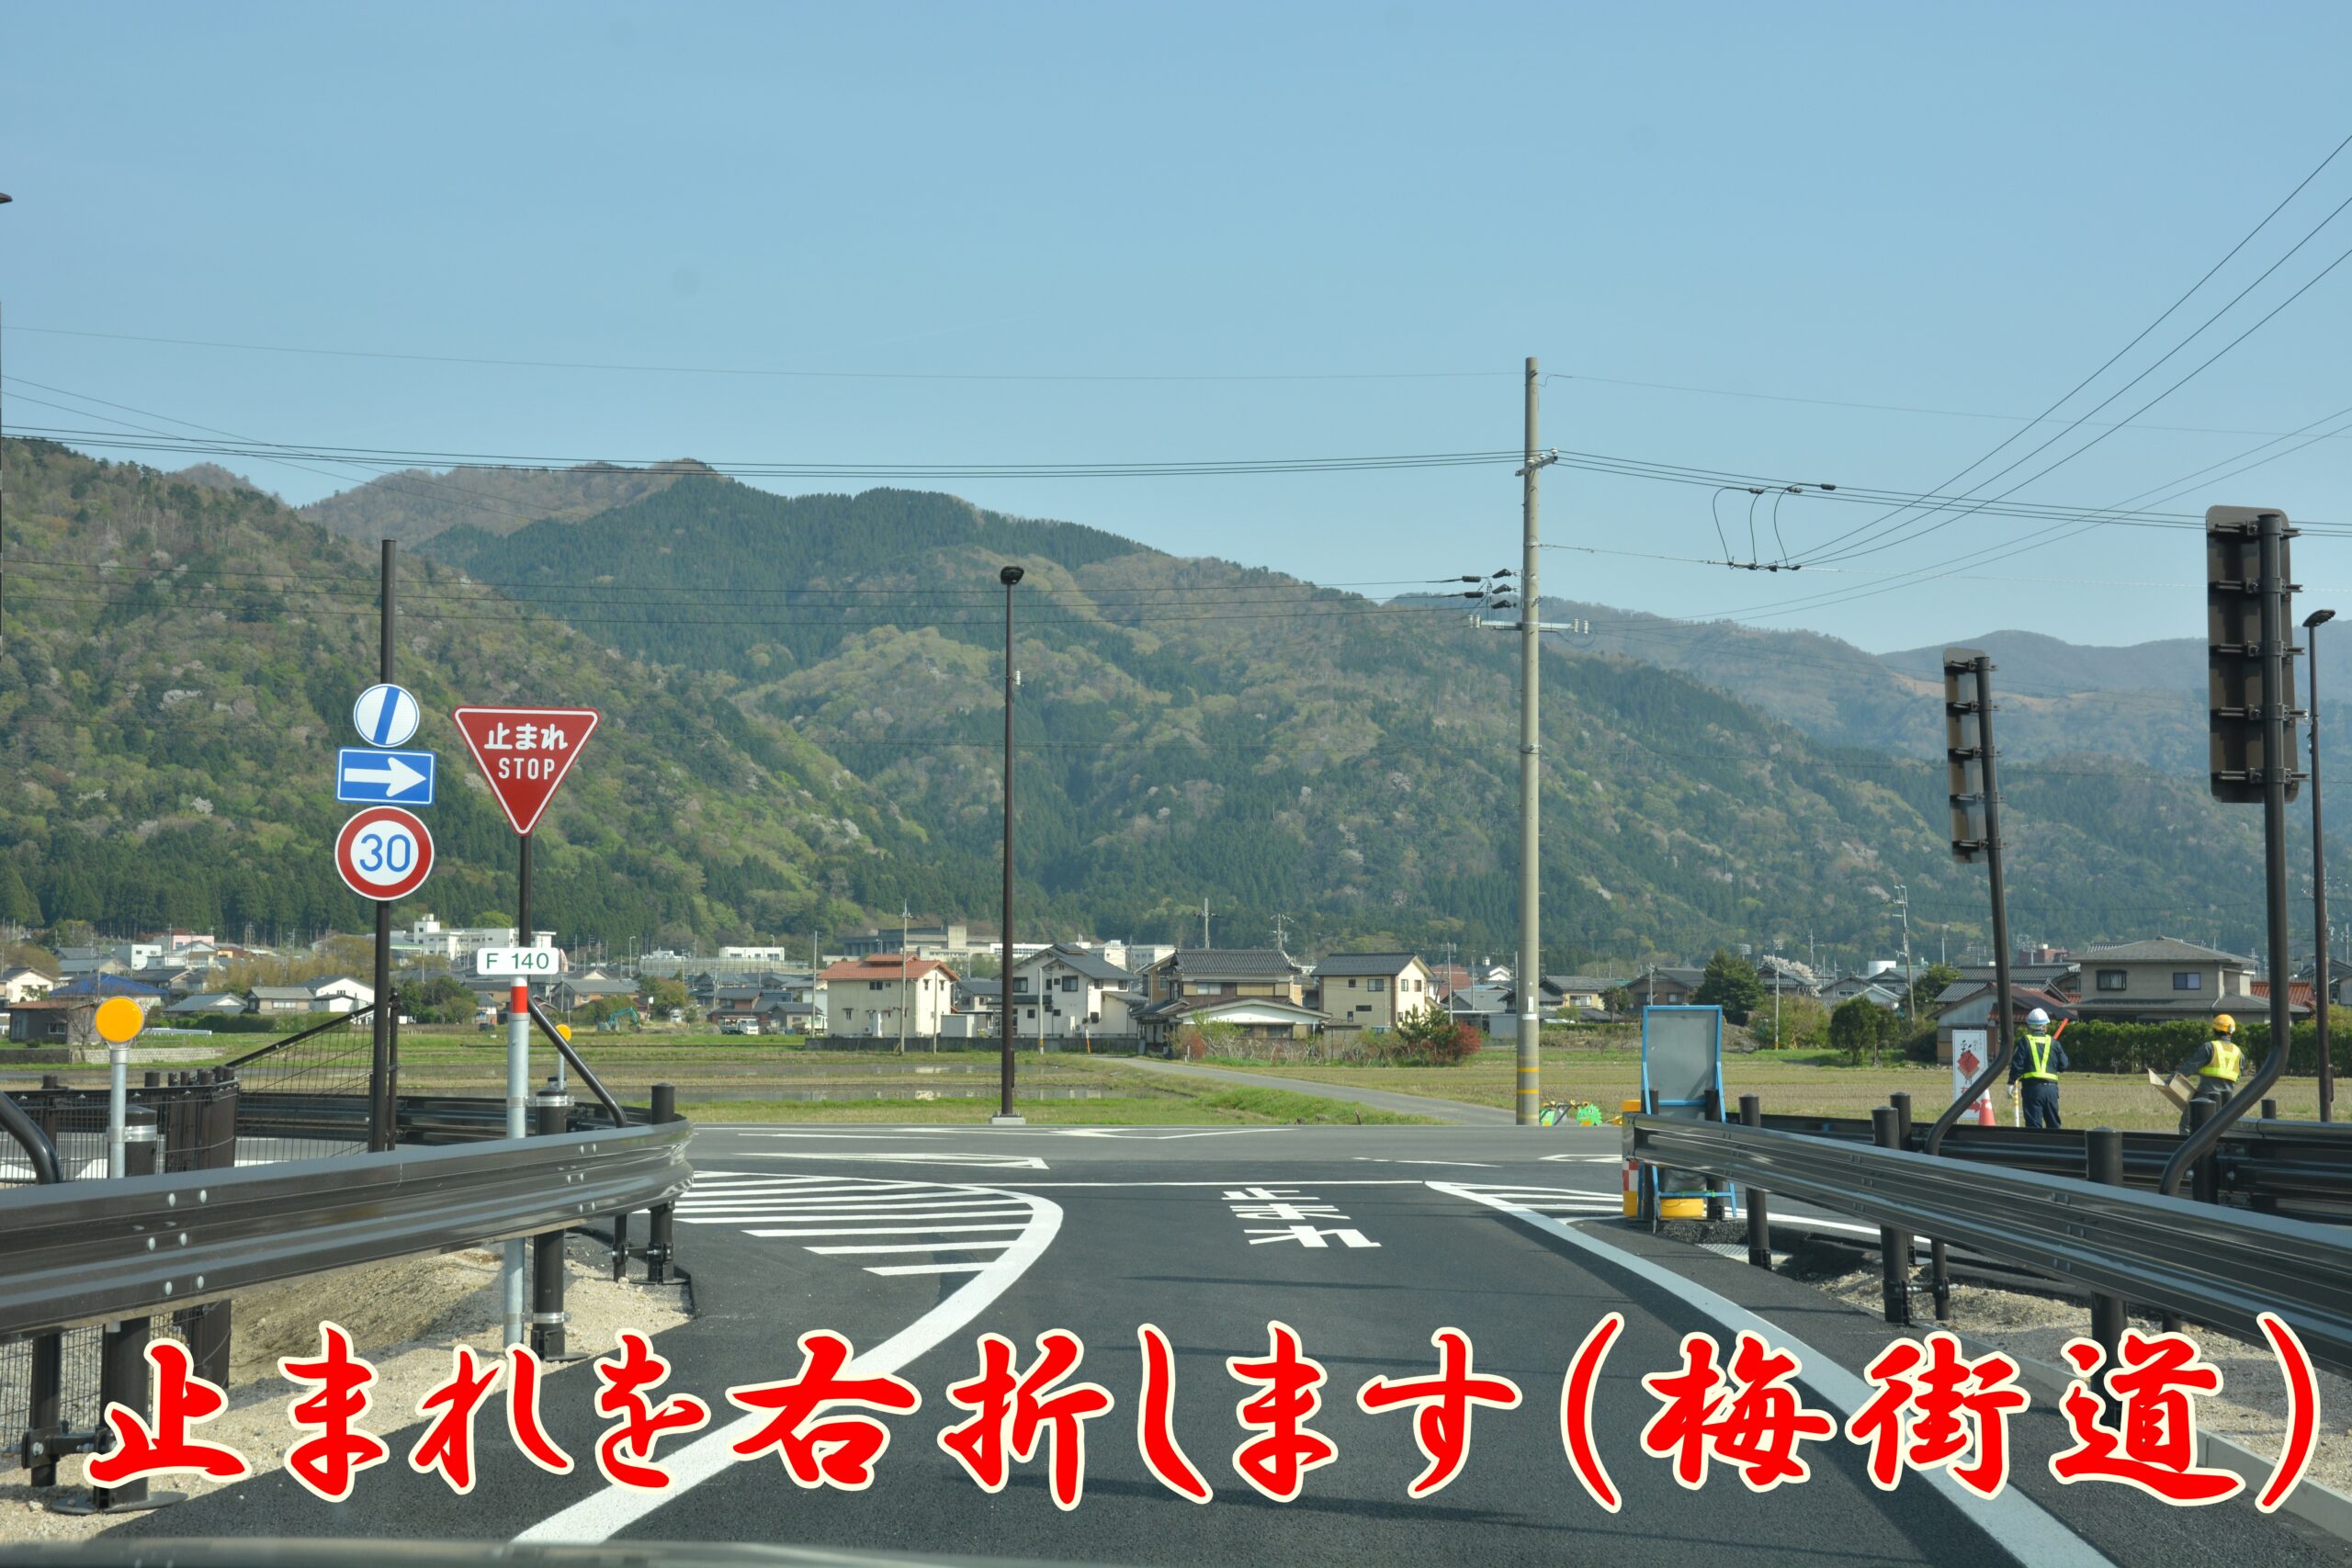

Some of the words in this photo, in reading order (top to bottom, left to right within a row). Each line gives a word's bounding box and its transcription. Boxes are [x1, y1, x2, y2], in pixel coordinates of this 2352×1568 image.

[484, 723, 568, 750] 止まれ
[498, 758, 555, 779] STOP
[359, 833, 411, 873] 30
[486, 953, 499, 969] F
[512, 953, 549, 969] 140
[1221, 1188, 1382, 1247] 止まれ
